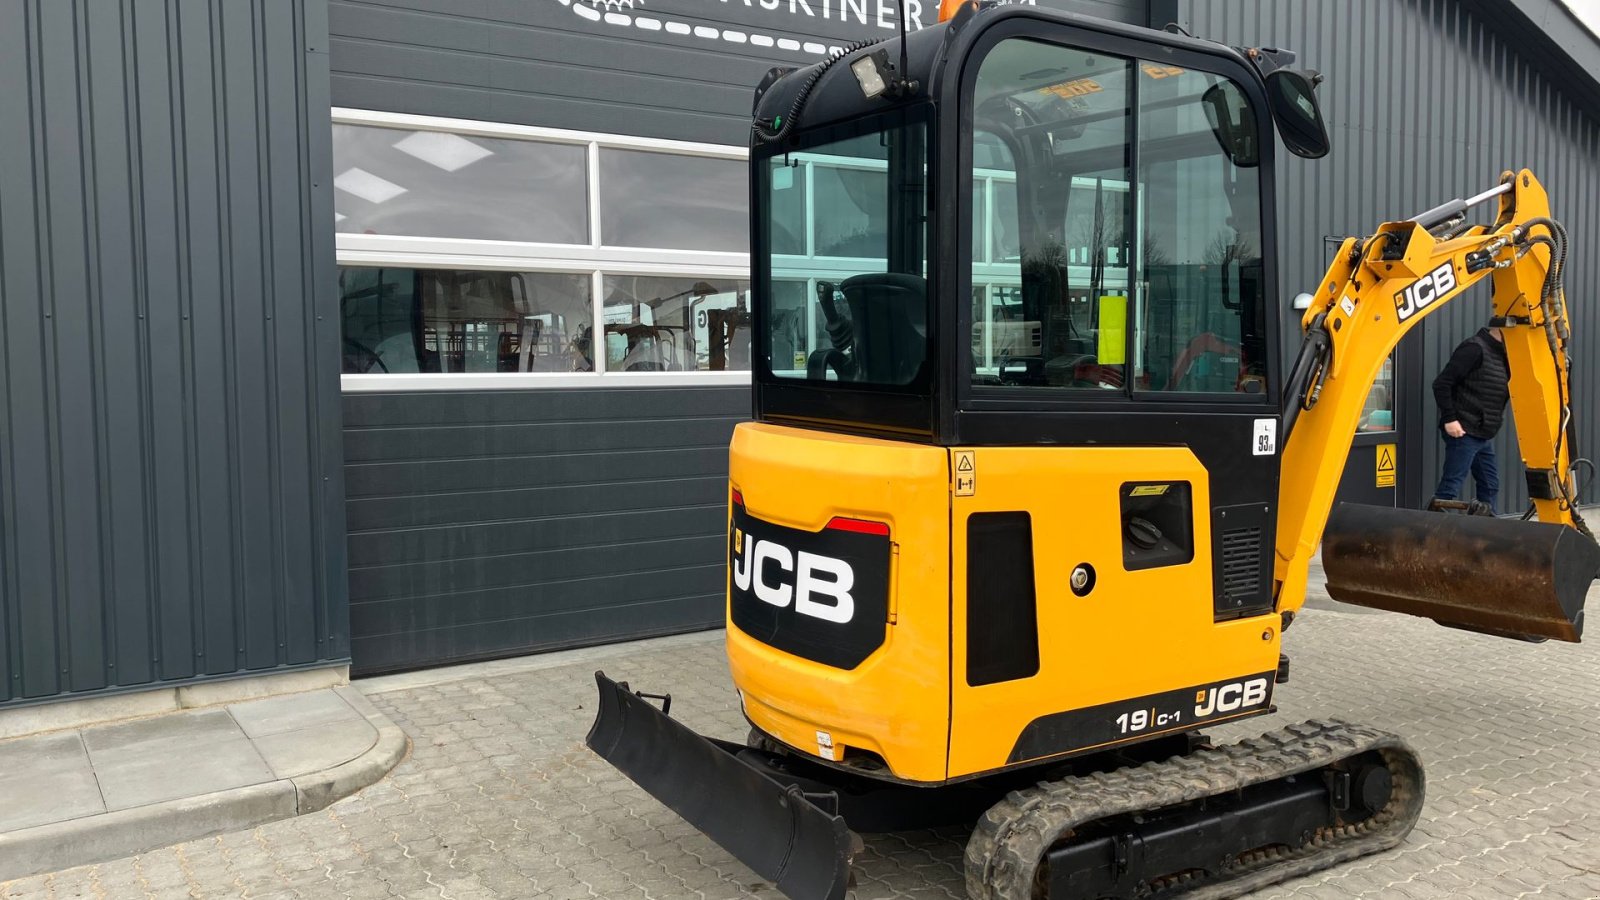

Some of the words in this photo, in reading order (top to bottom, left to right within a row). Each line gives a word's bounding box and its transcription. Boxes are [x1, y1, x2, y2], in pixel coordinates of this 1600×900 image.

[1397, 263, 1456, 320] JCB
[734, 533, 855, 624] JCB
[1116, 709, 1148, 734] 19
[1194, 677, 1268, 717] JCB
